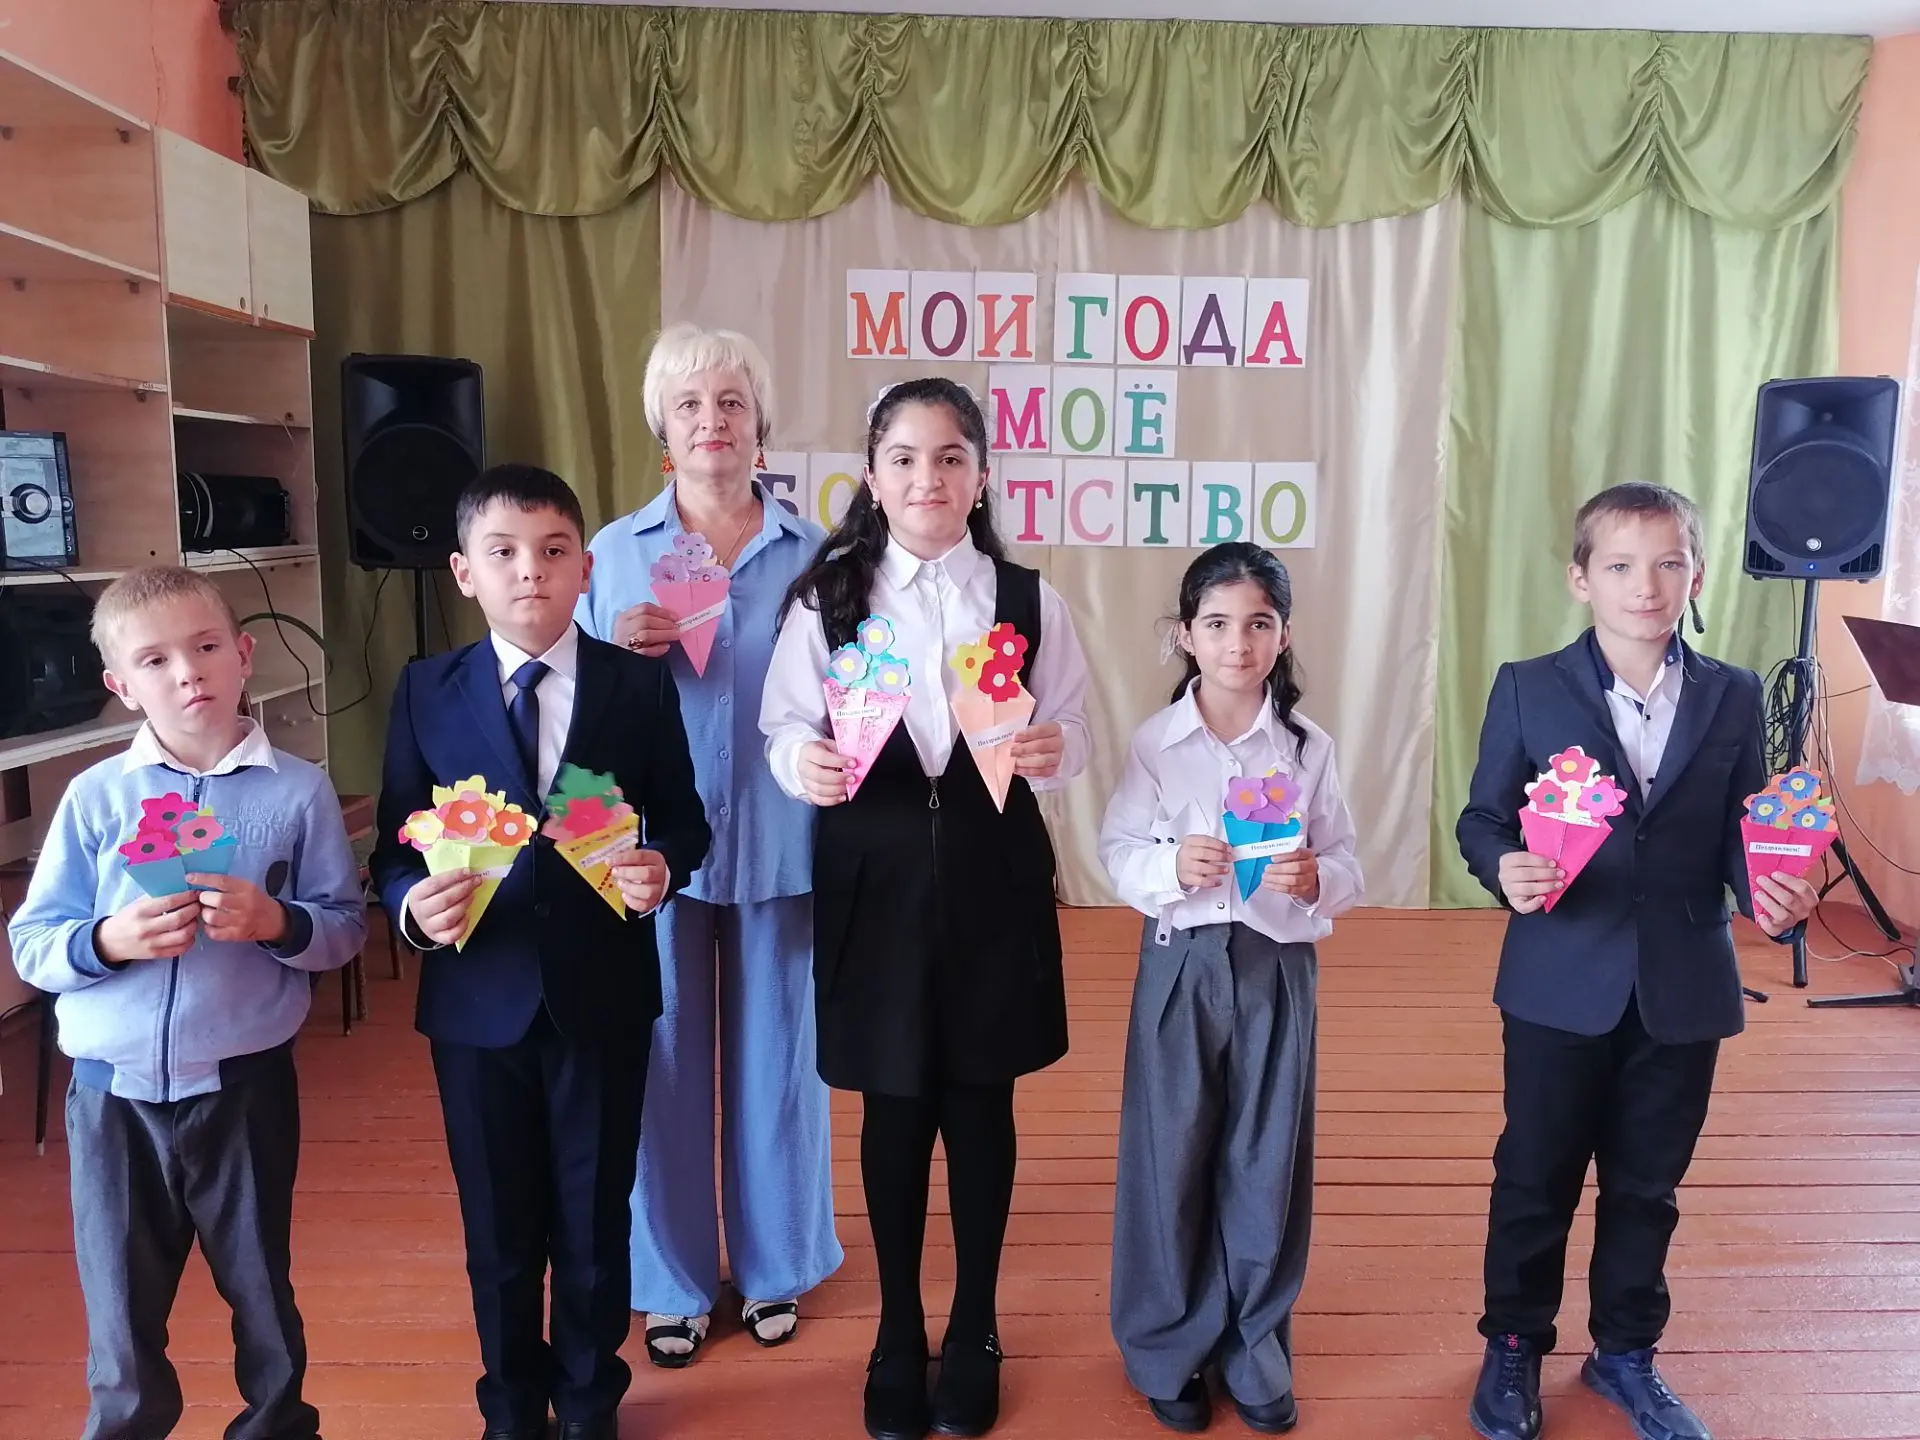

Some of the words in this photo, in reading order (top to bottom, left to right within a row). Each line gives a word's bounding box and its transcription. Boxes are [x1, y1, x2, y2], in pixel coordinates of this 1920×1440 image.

[849, 290, 1035, 358] МОИ
[1065, 293, 1303, 366] ГОДА
[990, 383, 1167, 454] МОЁ
[756, 472, 1308, 545] БОТСТВО
